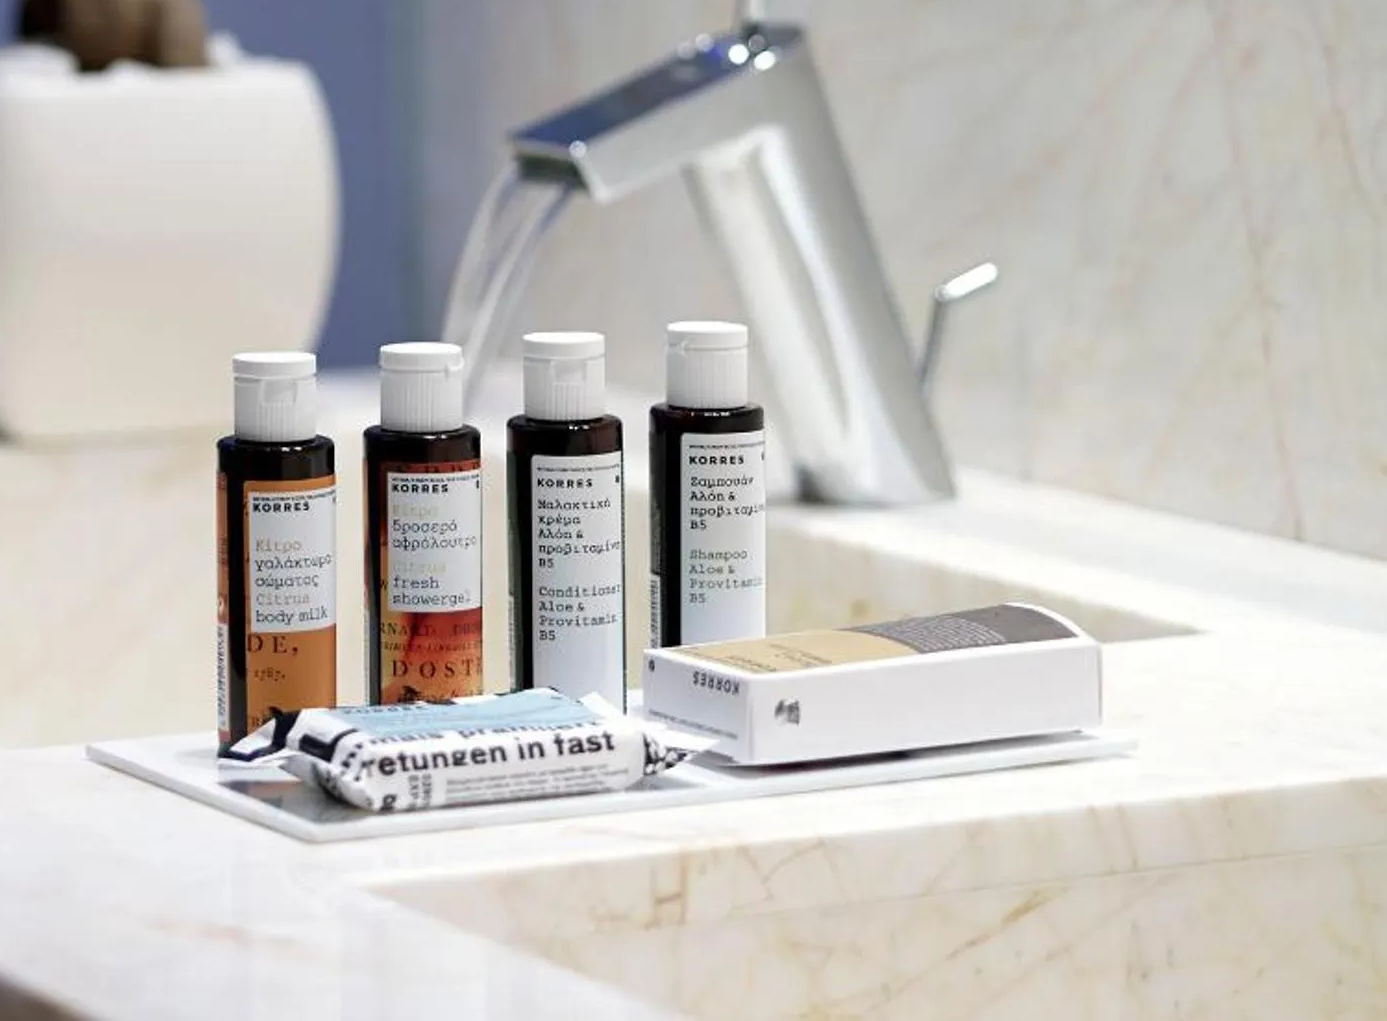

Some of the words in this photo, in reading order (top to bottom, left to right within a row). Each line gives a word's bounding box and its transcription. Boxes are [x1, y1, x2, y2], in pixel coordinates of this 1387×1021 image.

[689, 456, 744, 465] KORRES
[392, 483, 449, 494] KORRES
[537, 478, 593, 488] KORRES
[728, 491, 736, 501] &
[252, 502, 310, 513] KORRES
[690, 519, 707, 530] B5
[690, 549, 748, 562] Shampoo
[538, 558, 554, 568] B5
[689, 564, 723, 574] Aloe
[393, 577, 440, 589] fresh
[689, 593, 706, 603] B5
[539, 601, 573, 612] Aloe
[578, 602, 585, 612] &
[256, 610, 294, 626] body
[299, 606, 328, 621] milk
[539, 630, 556, 641] B5
[692, 671, 741, 696] KORRES
[517, 737, 546, 761] in
[554, 730, 616, 756] fast
